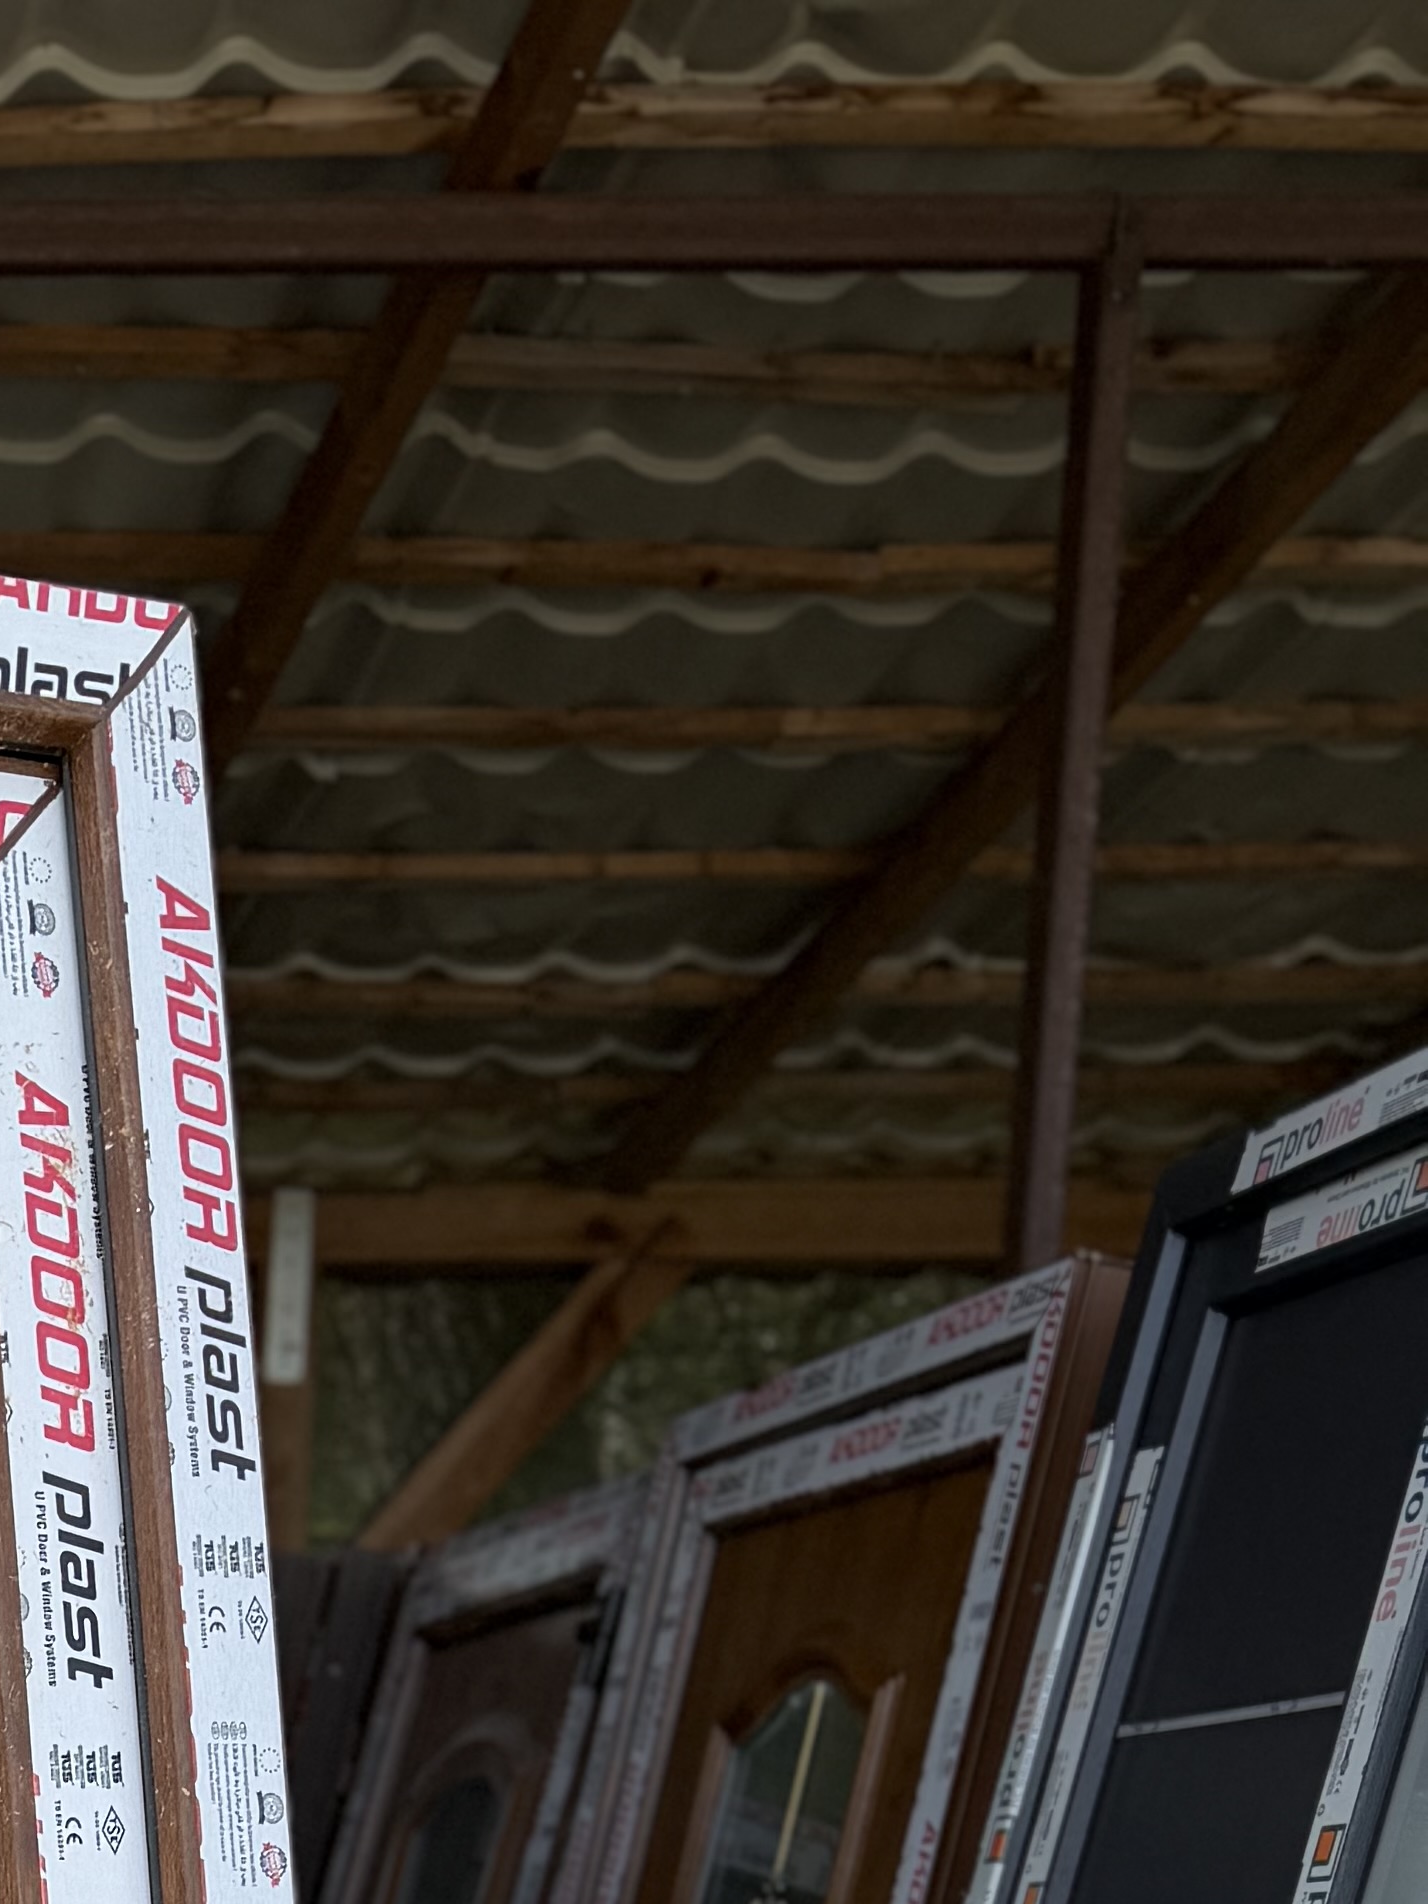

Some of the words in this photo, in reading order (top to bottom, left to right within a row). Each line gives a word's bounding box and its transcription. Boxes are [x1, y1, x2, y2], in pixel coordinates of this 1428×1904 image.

[157, 877, 237, 1252] AKDOOR
[1280, 1097, 1365, 1169] proline
[15, 1072, 95, 1452] AKDOOR
[1016, 1291, 1066, 1449] KDOOR
[185, 1266, 255, 1480] plast
[43, 1471, 114, 1689] plast
